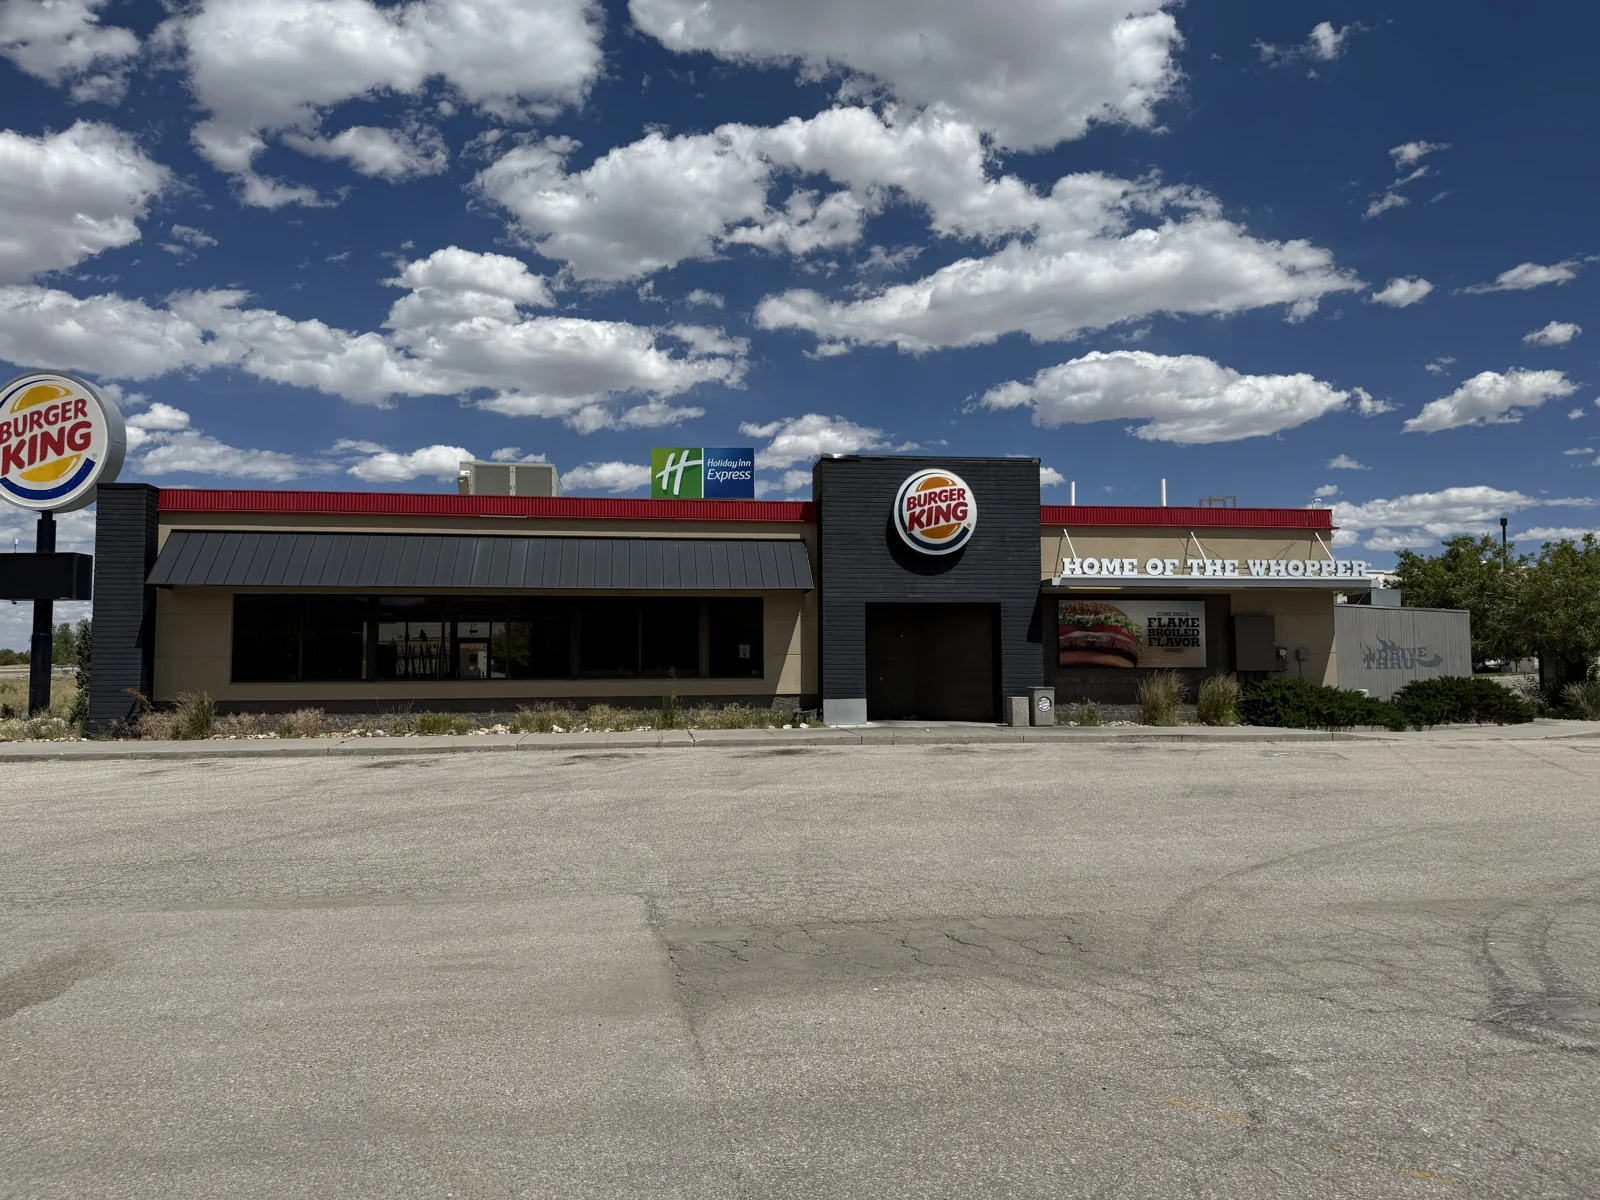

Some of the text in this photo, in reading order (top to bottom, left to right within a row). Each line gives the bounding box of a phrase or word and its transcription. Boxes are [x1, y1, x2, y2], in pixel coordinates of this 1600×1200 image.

[0, 398, 88, 446] BURGER
[1, 420, 93, 477] KING
[707, 458, 751, 469] Holiday Inn
[707, 468, 751, 483] Express
[906, 487, 967, 513] BURGER
[907, 501, 969, 533] KING
[1062, 557, 1368, 577] HOME OF THE WHOPPER
[1147, 617, 1200, 628] FLAME
[1147, 628, 1200, 637] BROILED
[1147, 637, 1201, 647] FLAVOR
[1377, 646, 1428, 658] DRIVE
[1363, 654, 1416, 670] THRU
